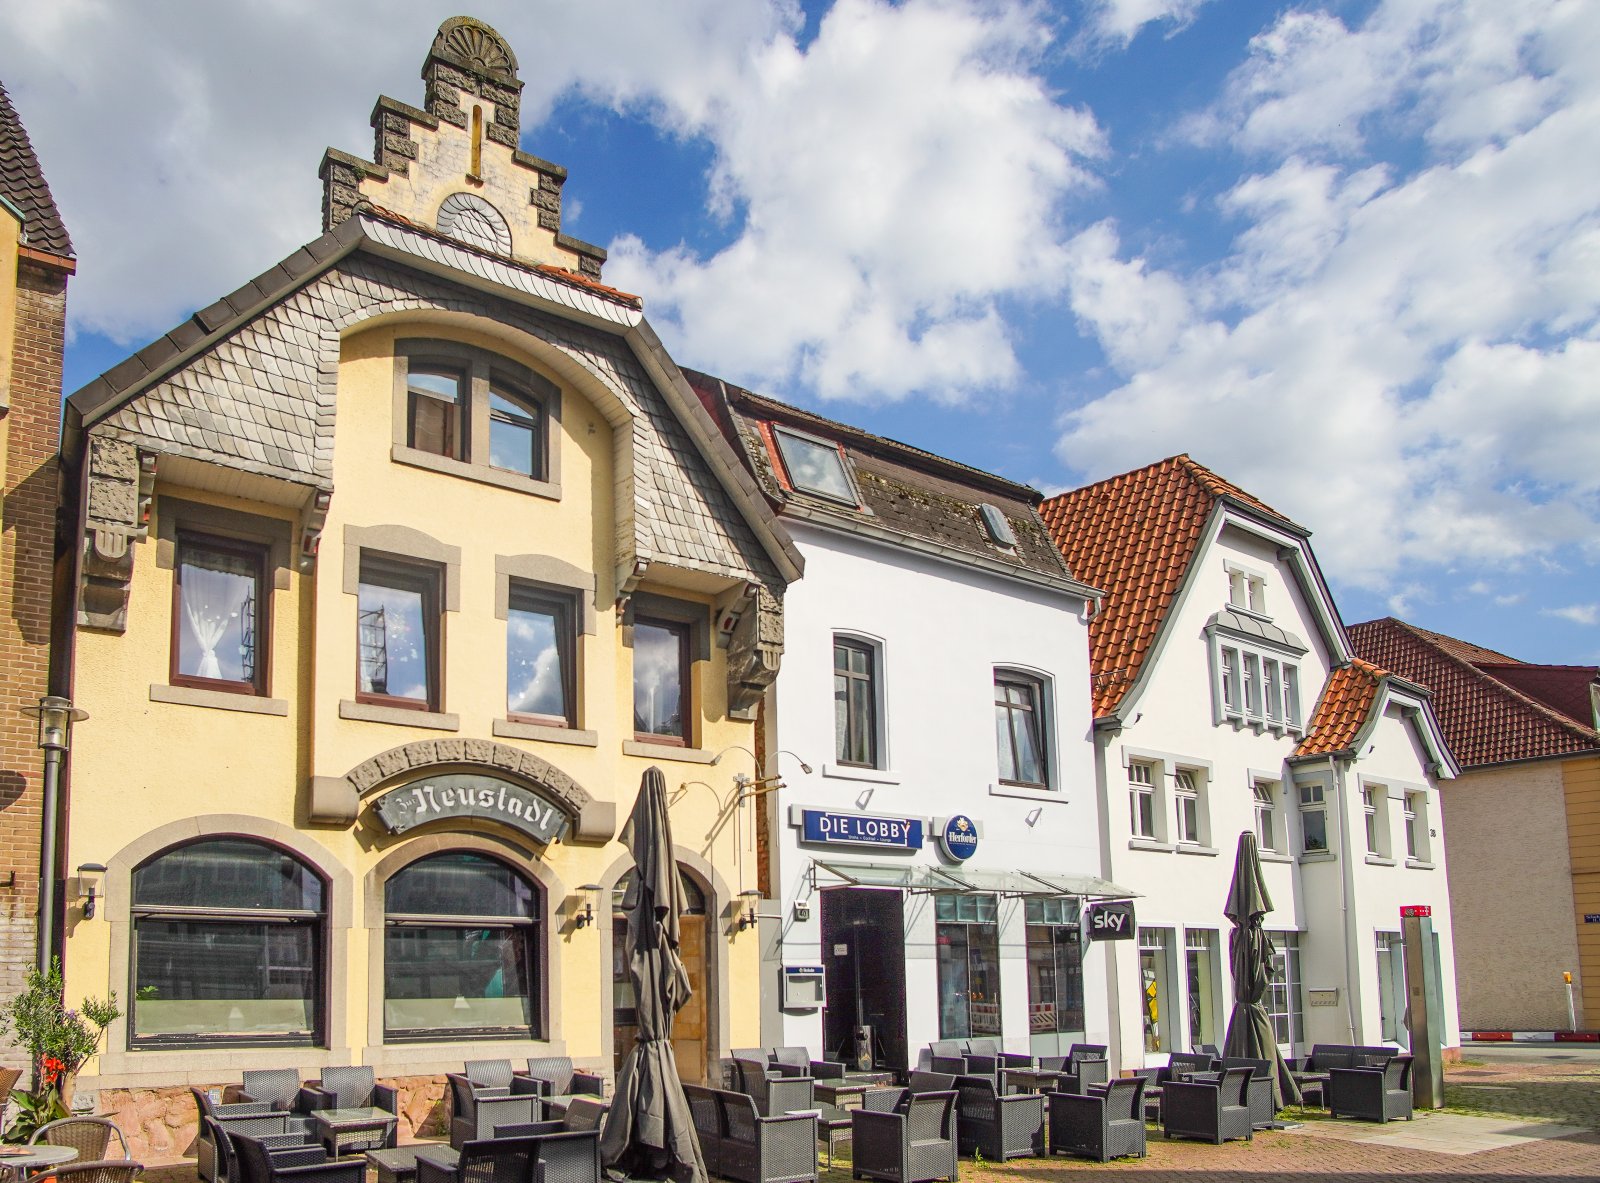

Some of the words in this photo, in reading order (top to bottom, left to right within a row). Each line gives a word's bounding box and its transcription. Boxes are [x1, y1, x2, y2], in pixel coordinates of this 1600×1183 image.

[820, 816, 849, 834] DIE
[857, 820, 911, 839] LOBBY
[1094, 910, 1126, 932] sky
